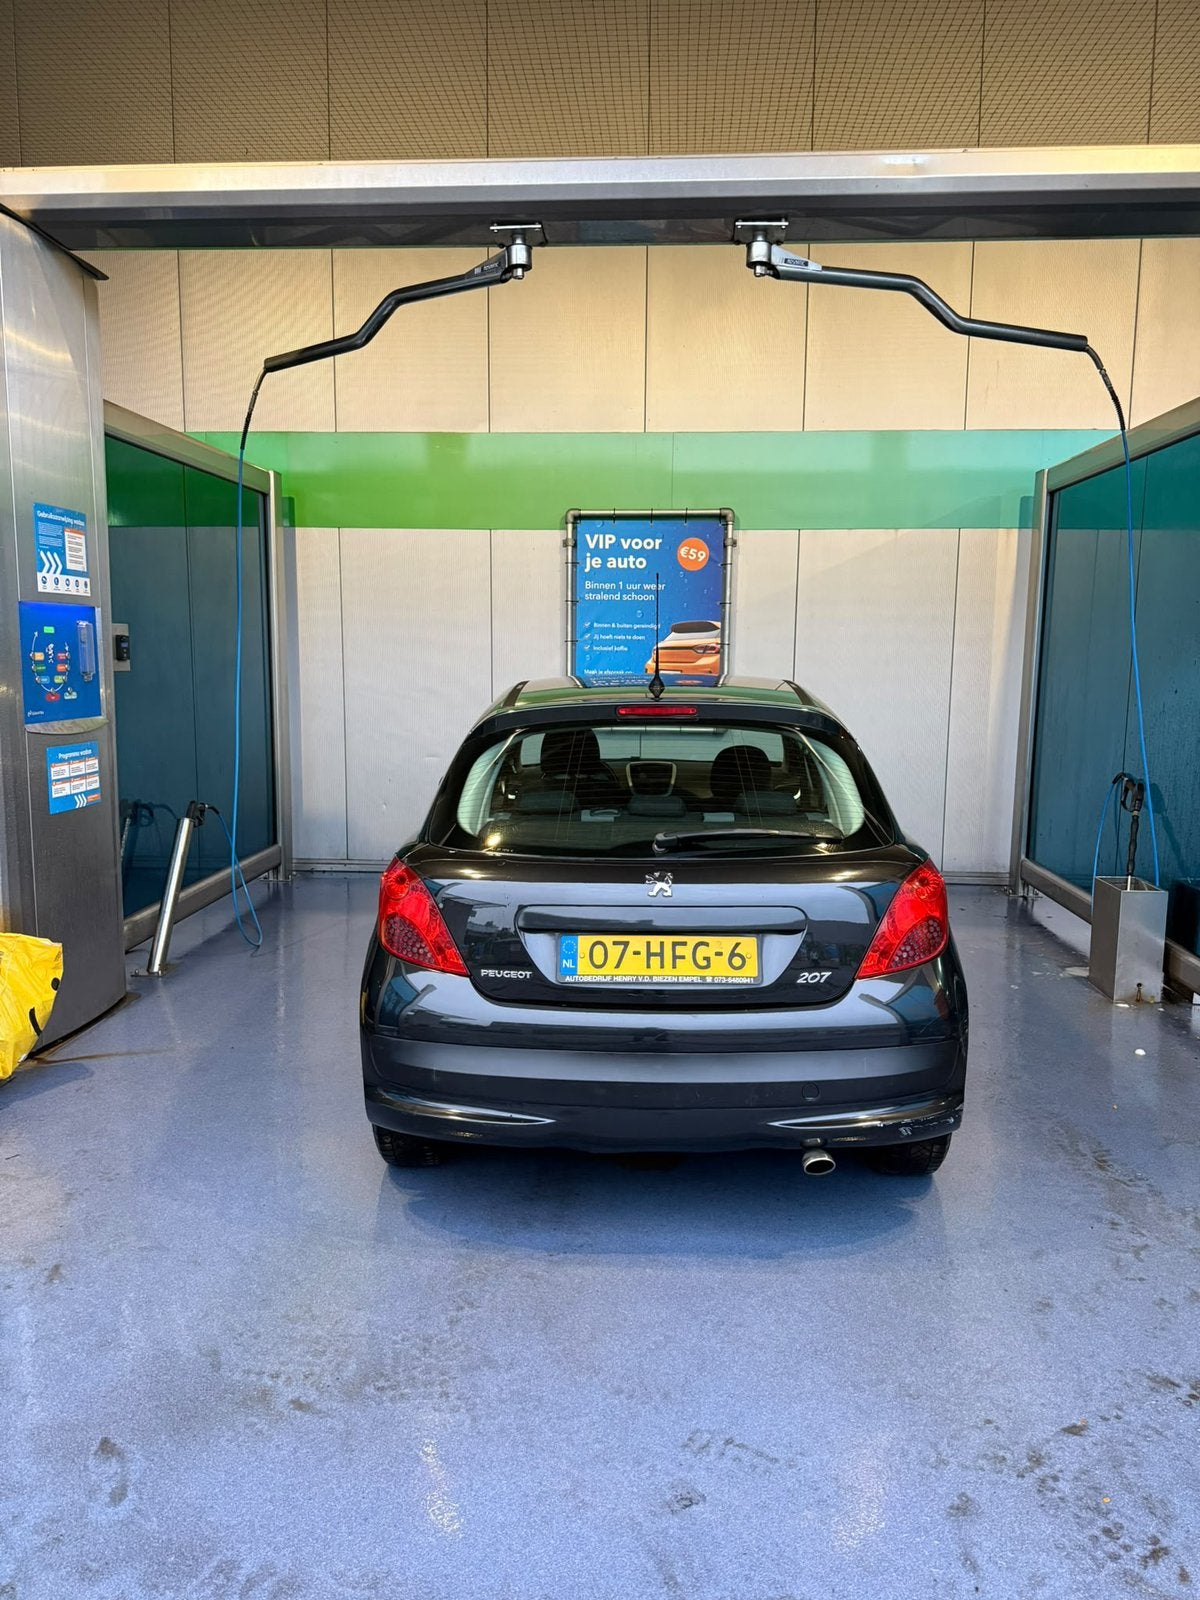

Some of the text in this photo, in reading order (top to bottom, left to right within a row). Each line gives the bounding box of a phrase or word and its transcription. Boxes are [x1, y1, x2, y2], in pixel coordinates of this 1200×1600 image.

[585, 534, 662, 549] VIP voor
[680, 546, 706, 562] €59
[584, 552, 647, 572] je auto
[585, 581, 616, 590] Binnen
[619, 582, 623, 590] 1
[585, 591, 655, 600] stralend schoon
[588, 940, 747, 970] 07-HFG-6
[562, 959, 575, 968] NL
[481, 969, 532, 978] PEUGEOT
[796, 972, 831, 983] 207
